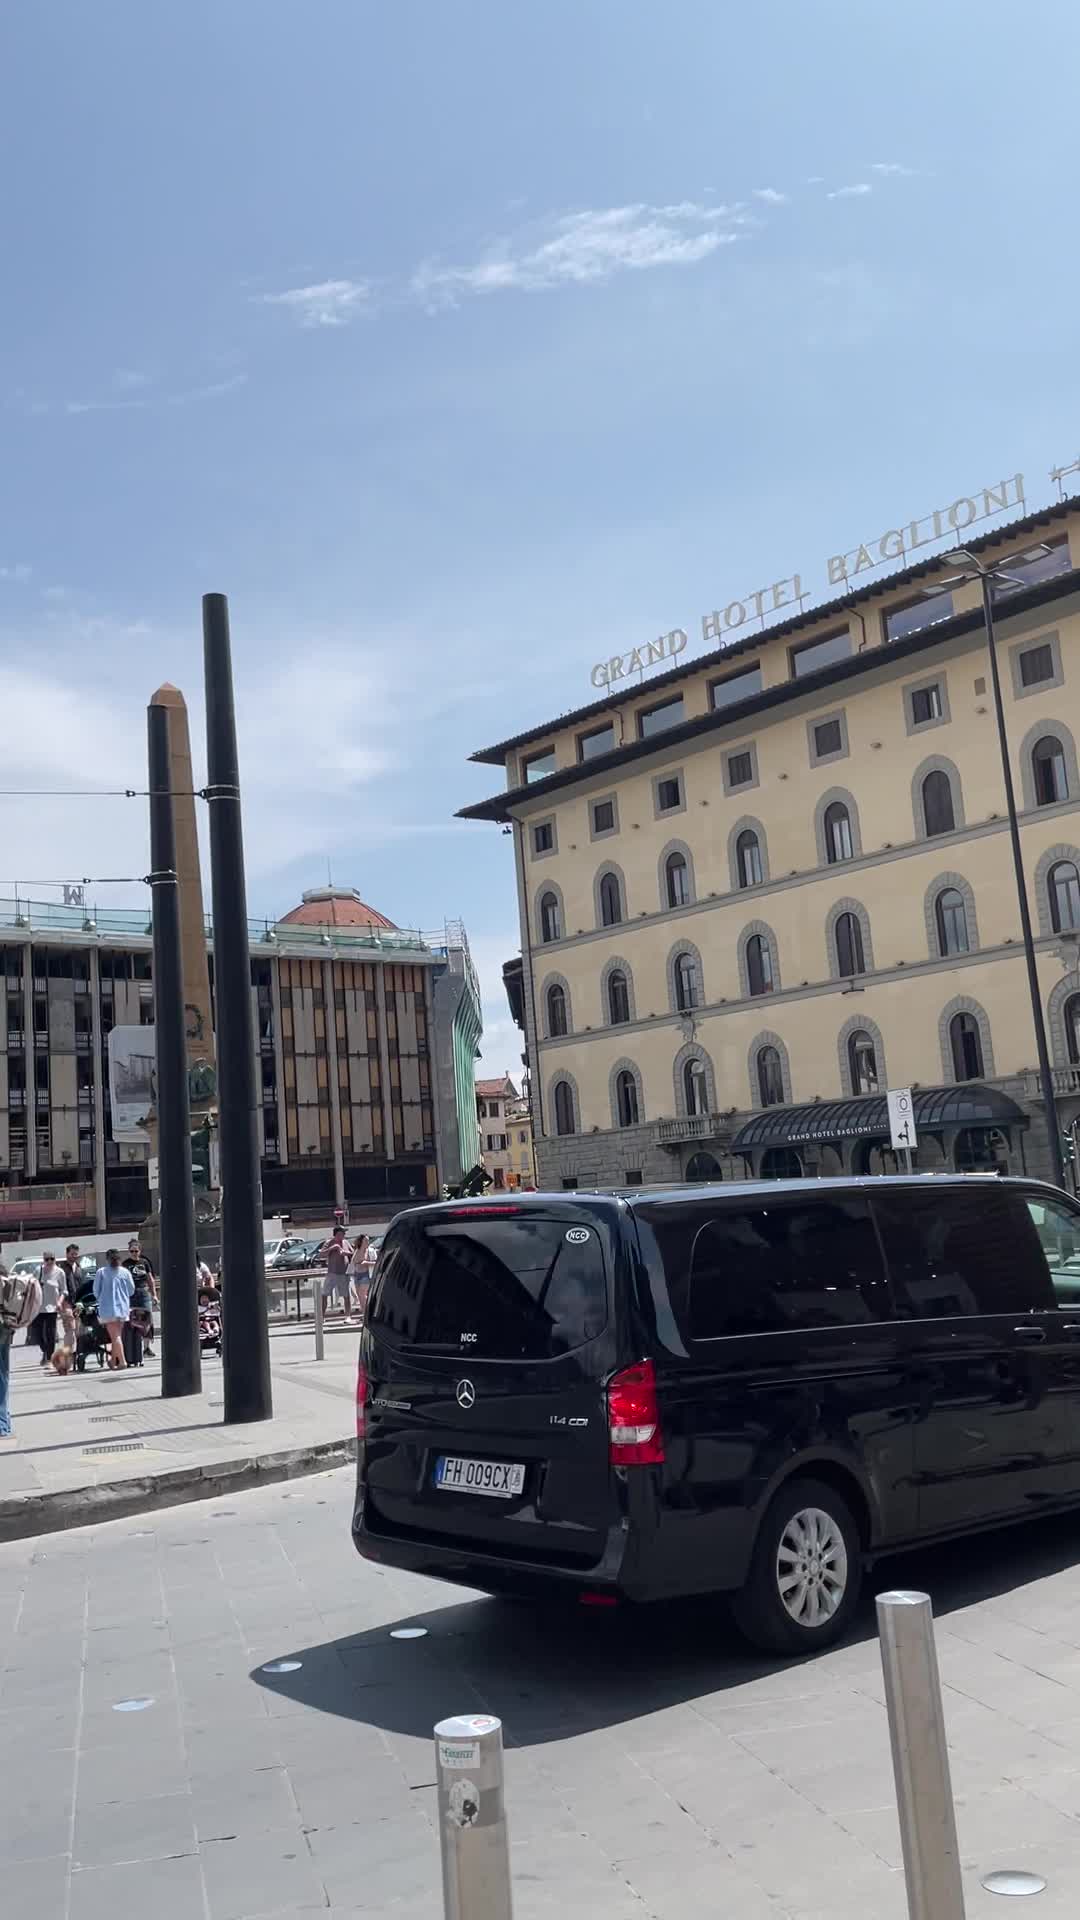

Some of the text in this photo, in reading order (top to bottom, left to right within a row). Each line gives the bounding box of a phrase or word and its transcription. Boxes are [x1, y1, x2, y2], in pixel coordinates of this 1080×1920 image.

[591, 473, 1025, 687] GRAND HOTEL BAGLIONI
[787, 1126, 872, 1141] GRAND HOTEL BAGLIONI
[460, 1333, 477, 1342] NCC
[568, 1417, 588, 1426] CDI
[444, 1459, 463, 1483] FH
[466, 1462, 511, 1490] 009CX
